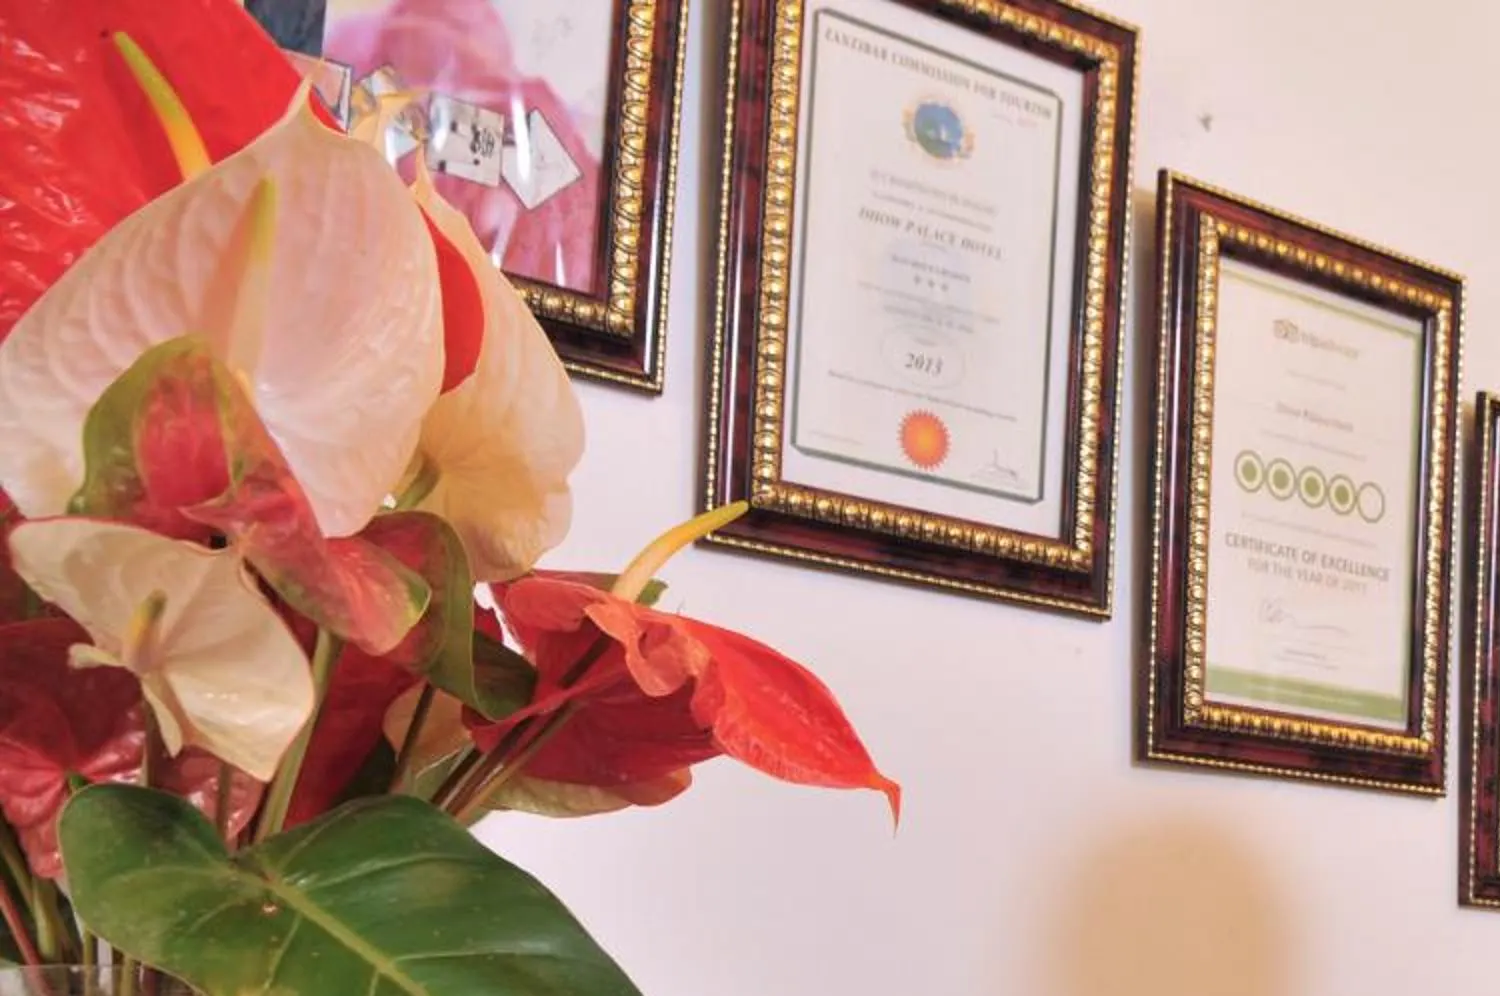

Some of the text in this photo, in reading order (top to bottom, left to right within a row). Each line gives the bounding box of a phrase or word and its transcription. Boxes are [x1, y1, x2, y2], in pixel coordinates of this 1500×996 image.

[824, 27, 888, 62] ZANZIBAR
[890, 50, 971, 92] COMMISSION
[972, 77, 998, 101] FOR
[1225, 532, 1392, 584] CERTIFICATE OF EXCELLENCE
[1271, 562, 1293, 579] THE
[1295, 567, 1323, 585] YEAR
